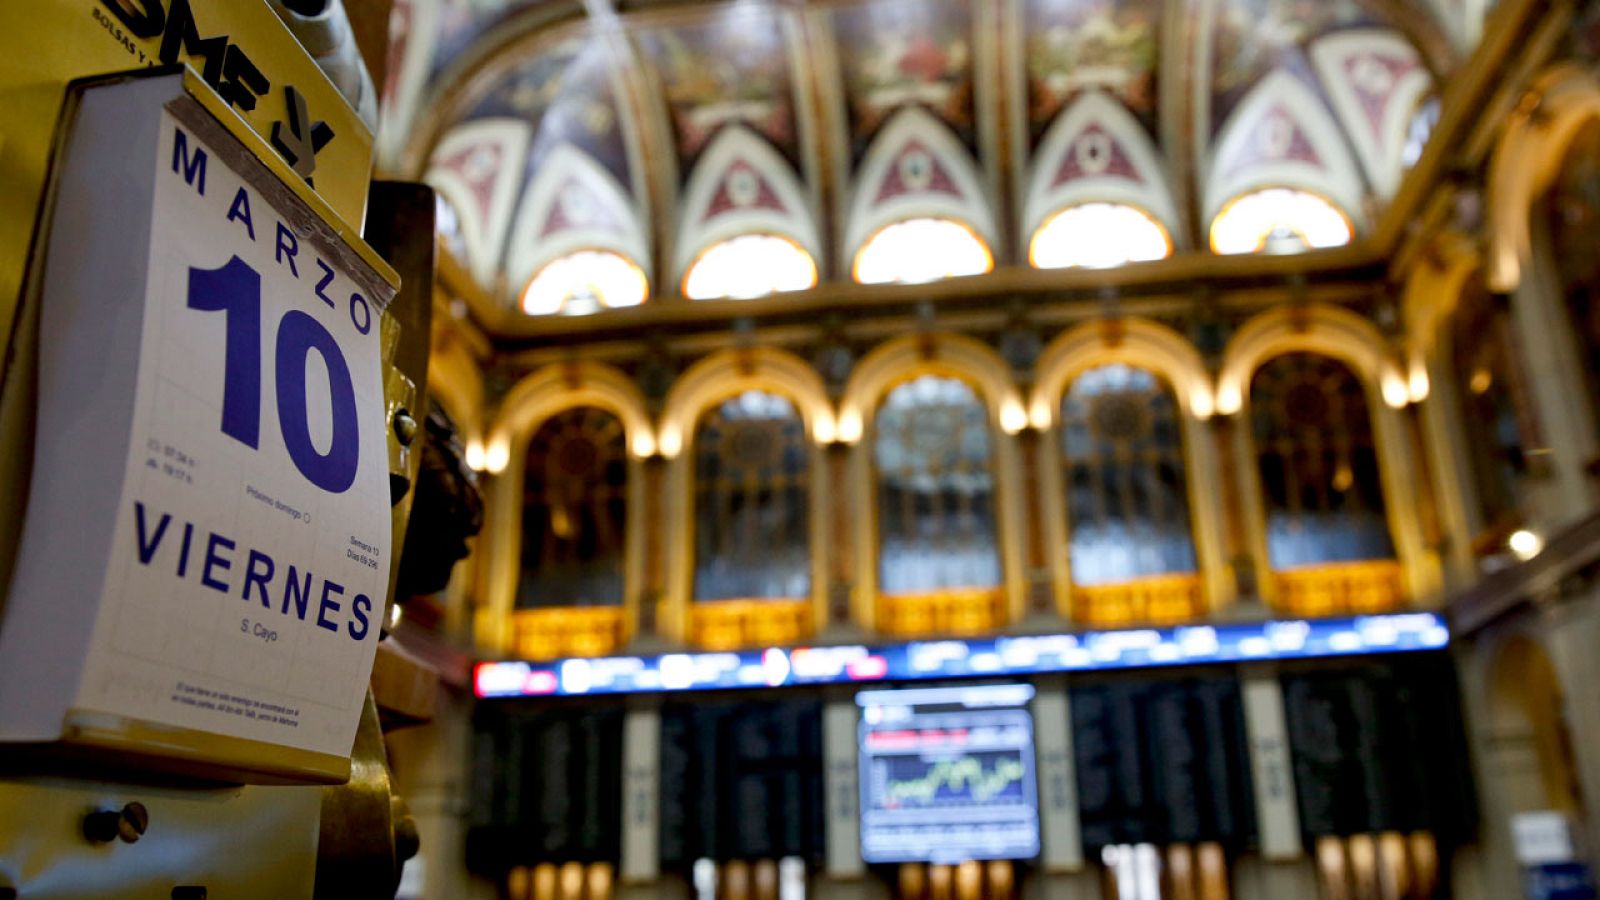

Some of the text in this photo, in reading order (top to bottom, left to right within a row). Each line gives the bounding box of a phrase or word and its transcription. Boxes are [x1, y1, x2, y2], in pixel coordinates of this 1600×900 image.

[93, 7, 145, 63] BOLSAS Y
[172, 127, 371, 335] MARZO
[187, 254, 359, 493] 10
[134, 501, 372, 640] VIERNES
[253, 622, 277, 642] Cayo
